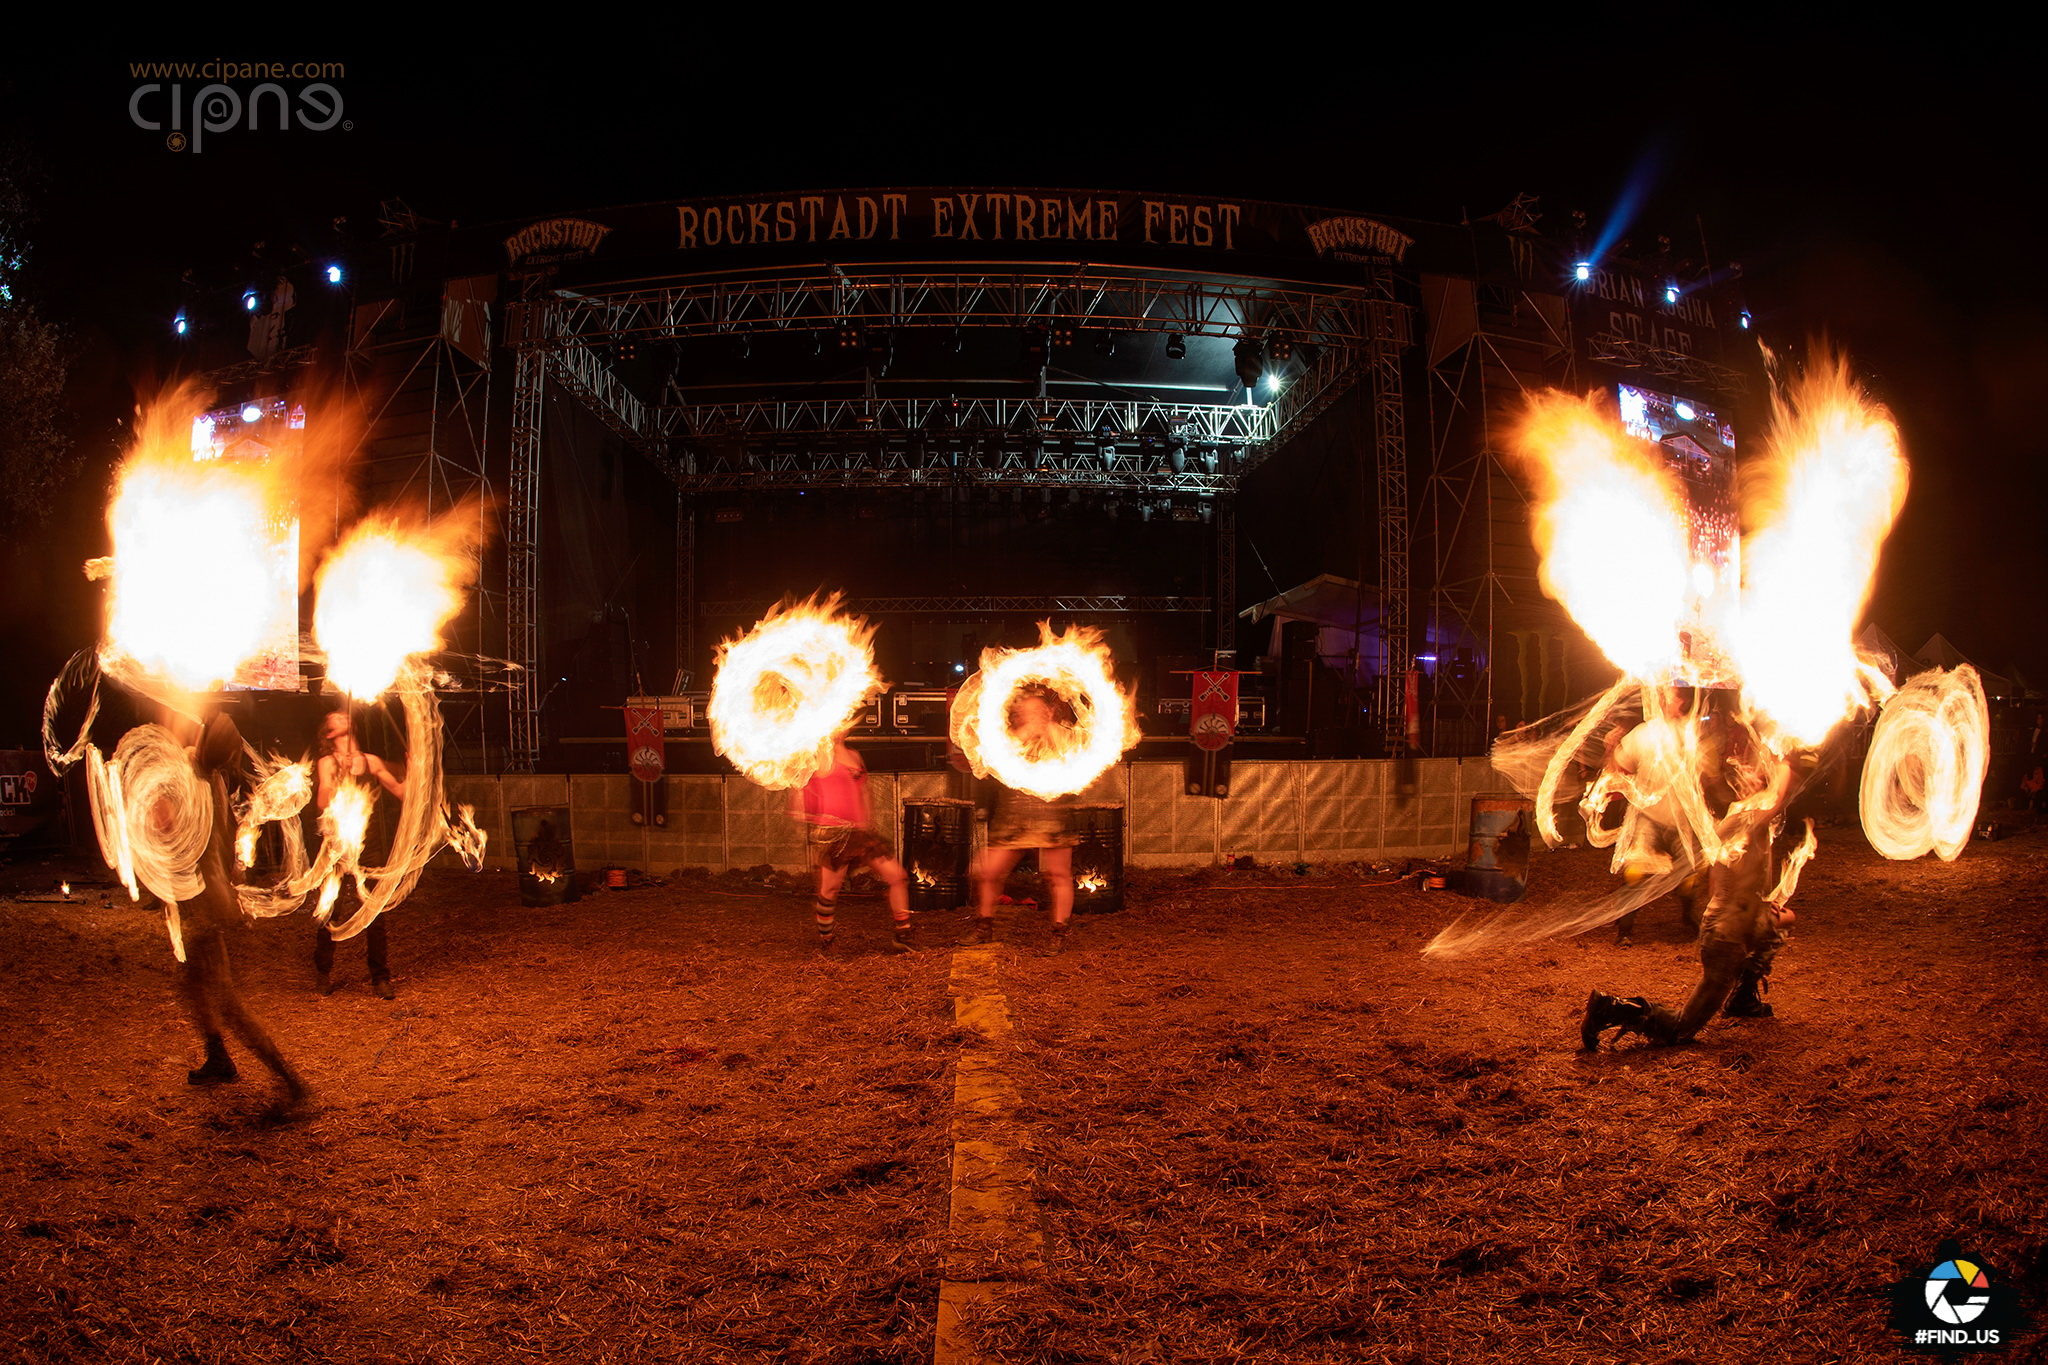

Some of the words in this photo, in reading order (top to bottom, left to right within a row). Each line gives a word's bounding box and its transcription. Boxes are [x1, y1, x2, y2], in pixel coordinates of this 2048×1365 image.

[676, 193, 907, 249] ROCKSTADT
[931, 193, 1120, 241] EXTREME
[1141, 199, 1241, 251] FEST
